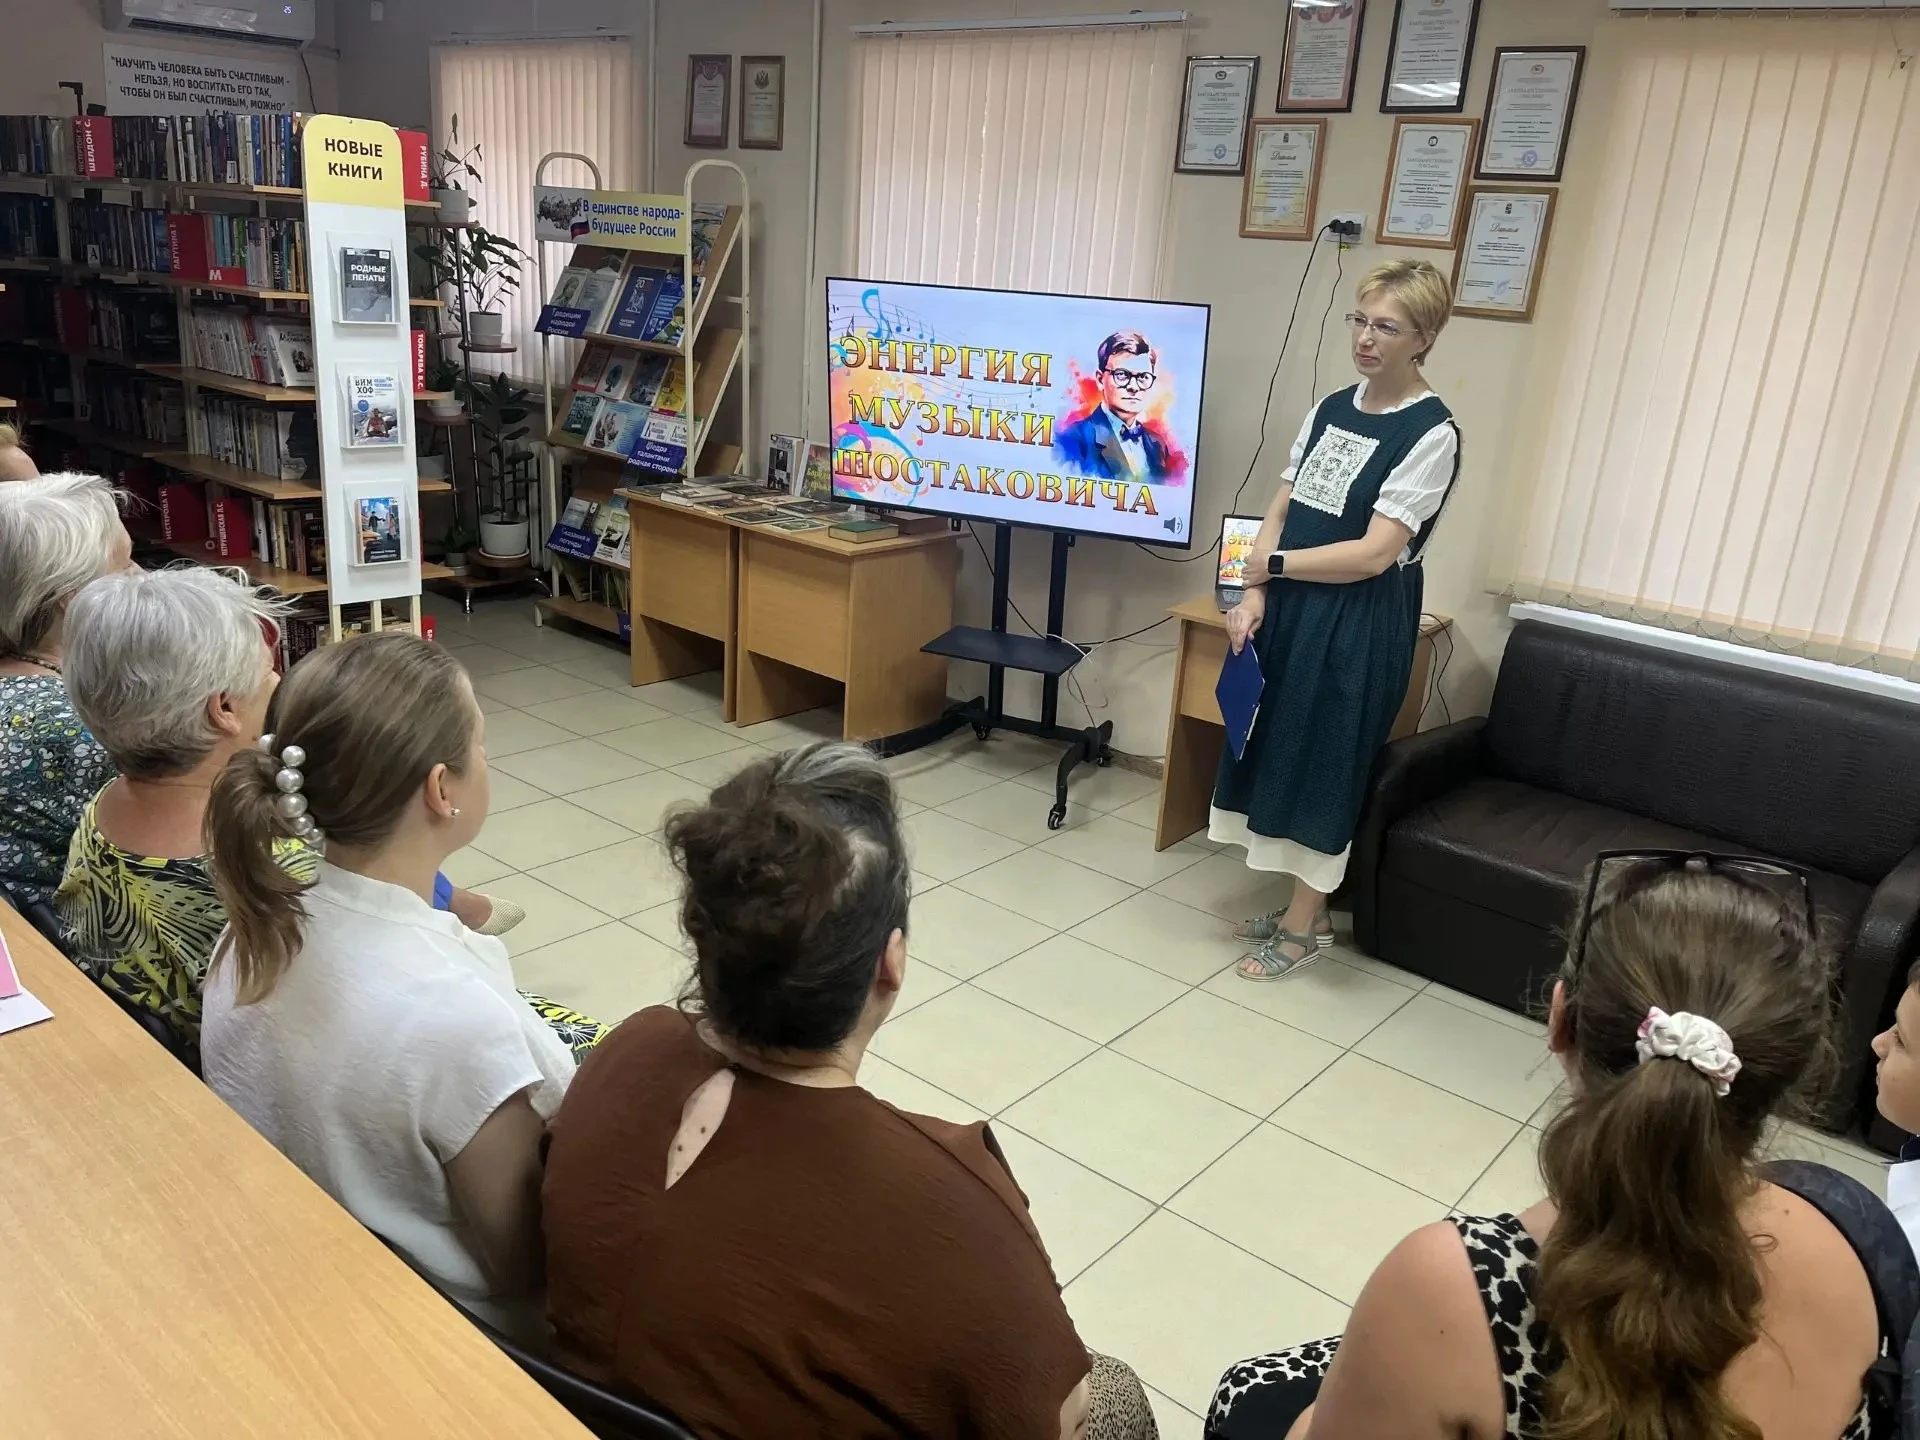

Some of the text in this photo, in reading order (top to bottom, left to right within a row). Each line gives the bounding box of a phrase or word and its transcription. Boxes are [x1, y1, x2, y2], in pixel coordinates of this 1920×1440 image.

[111, 56, 156, 71] "НАУЧИТЬ
[158, 62, 202, 76] ЧЕЛОВЕКА
[204, 68, 227, 78] БЫТЬ
[228, 70, 284, 85] СЧАСТЛИВЫМ
[134, 74, 272, 98] НЕЛЬЗЯ, НО ВОСПИТАТЬ ЕГО ТАК,
[120, 86, 151, 98] ЧТОБЫ
[153, 90, 166, 100] ОН
[168, 91, 187, 102] БЫЛ
[189, 93, 249, 109] СЧАСТЛИВЫМ,
[84, 119, 96, 172] ШЕЛДОН С.
[324, 137, 383, 158] НОВЫЕ
[328, 162, 383, 181] КНИГИ
[420, 145, 428, 189] РУБИНА Д.
[583, 199, 685, 220] В единстве народа-
[592, 217, 676, 238] будущее России
[170, 229, 181, 270] ЛАГУТИНА
[209, 269, 222, 280] М
[351, 264, 386, 273] РОДНЫЕ
[352, 274, 386, 282] ПЕНАТЫ
[840, 334, 1053, 388] ЭНЕРГИЯ
[355, 379, 373, 387] ВИМ
[848, 393, 1056, 448] МУЗЫКИ
[637, 451, 671, 463] талантами
[645, 442, 668, 453] Щедра
[627, 457, 678, 474] родная сторона
[834, 447, 1159, 516] ШОСТАКОВИЧА
[162, 498, 172, 540] НЕСТЕРОВА
[217, 513, 228, 556] ПЕТРУШЕВСКАЯ
